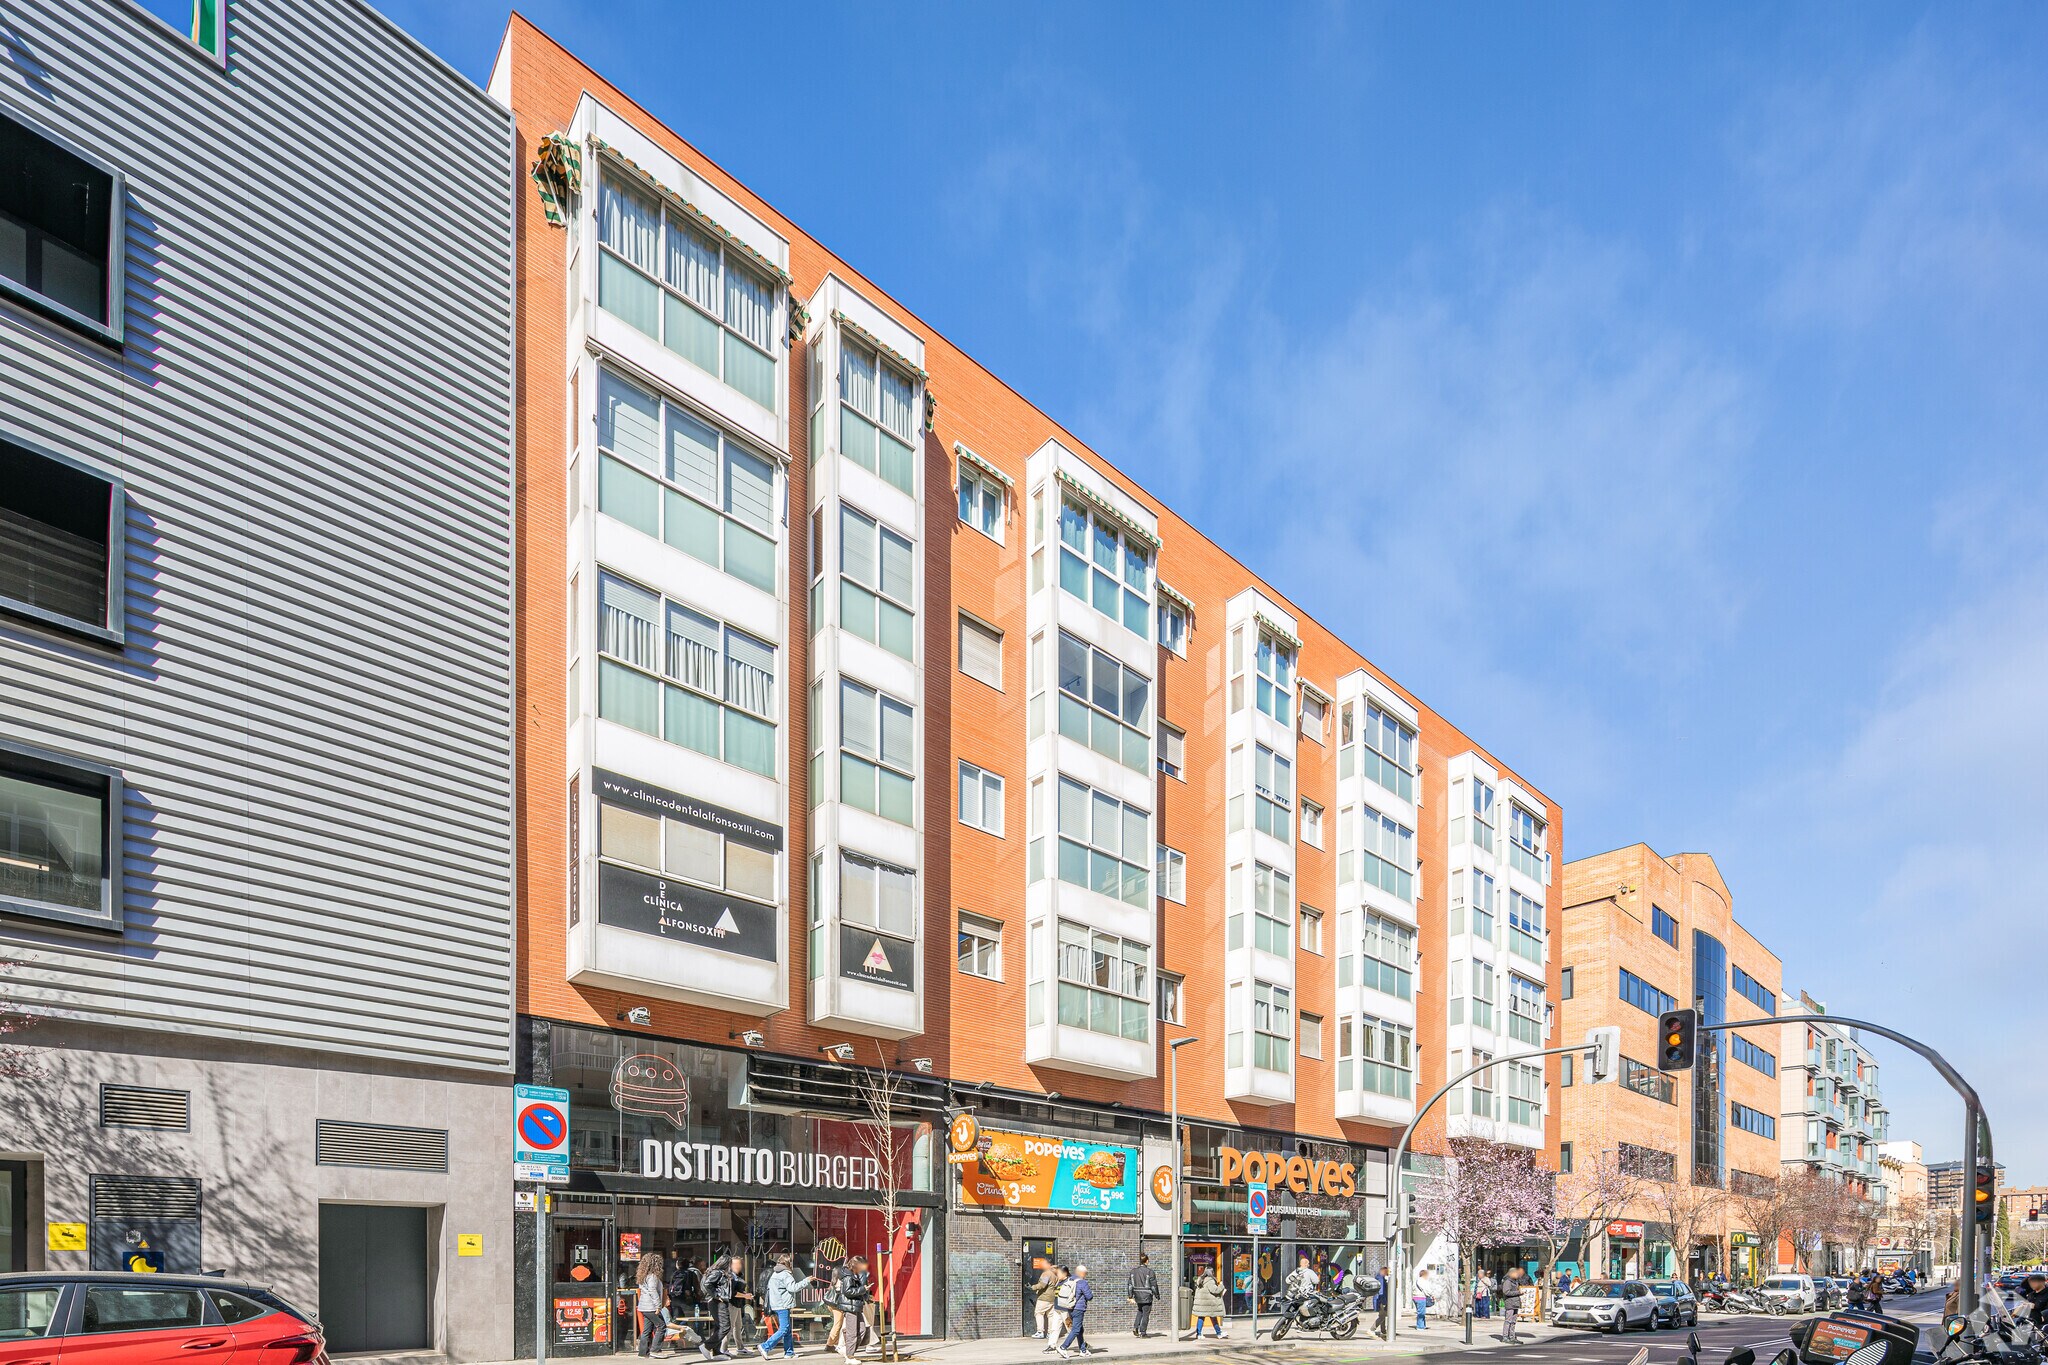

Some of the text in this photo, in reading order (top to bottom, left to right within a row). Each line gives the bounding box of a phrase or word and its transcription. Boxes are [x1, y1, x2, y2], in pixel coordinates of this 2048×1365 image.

[603, 781, 775, 840] www.clinicadentalalfonsoxiii.com
[643, 895, 683, 912] CLÍNICA
[1024, 1139, 1086, 1161] POPEYES
[642, 1138, 774, 1186] DISTRITO
[779, 1150, 880, 1191] BURGER
[976, 1182, 1008, 1195] Crunch
[1071, 1194, 1099, 1207] Crunch
[1298, 1206, 1322, 1217] KITCHEN
[1827, 1323, 1858, 1335] POPEYES
